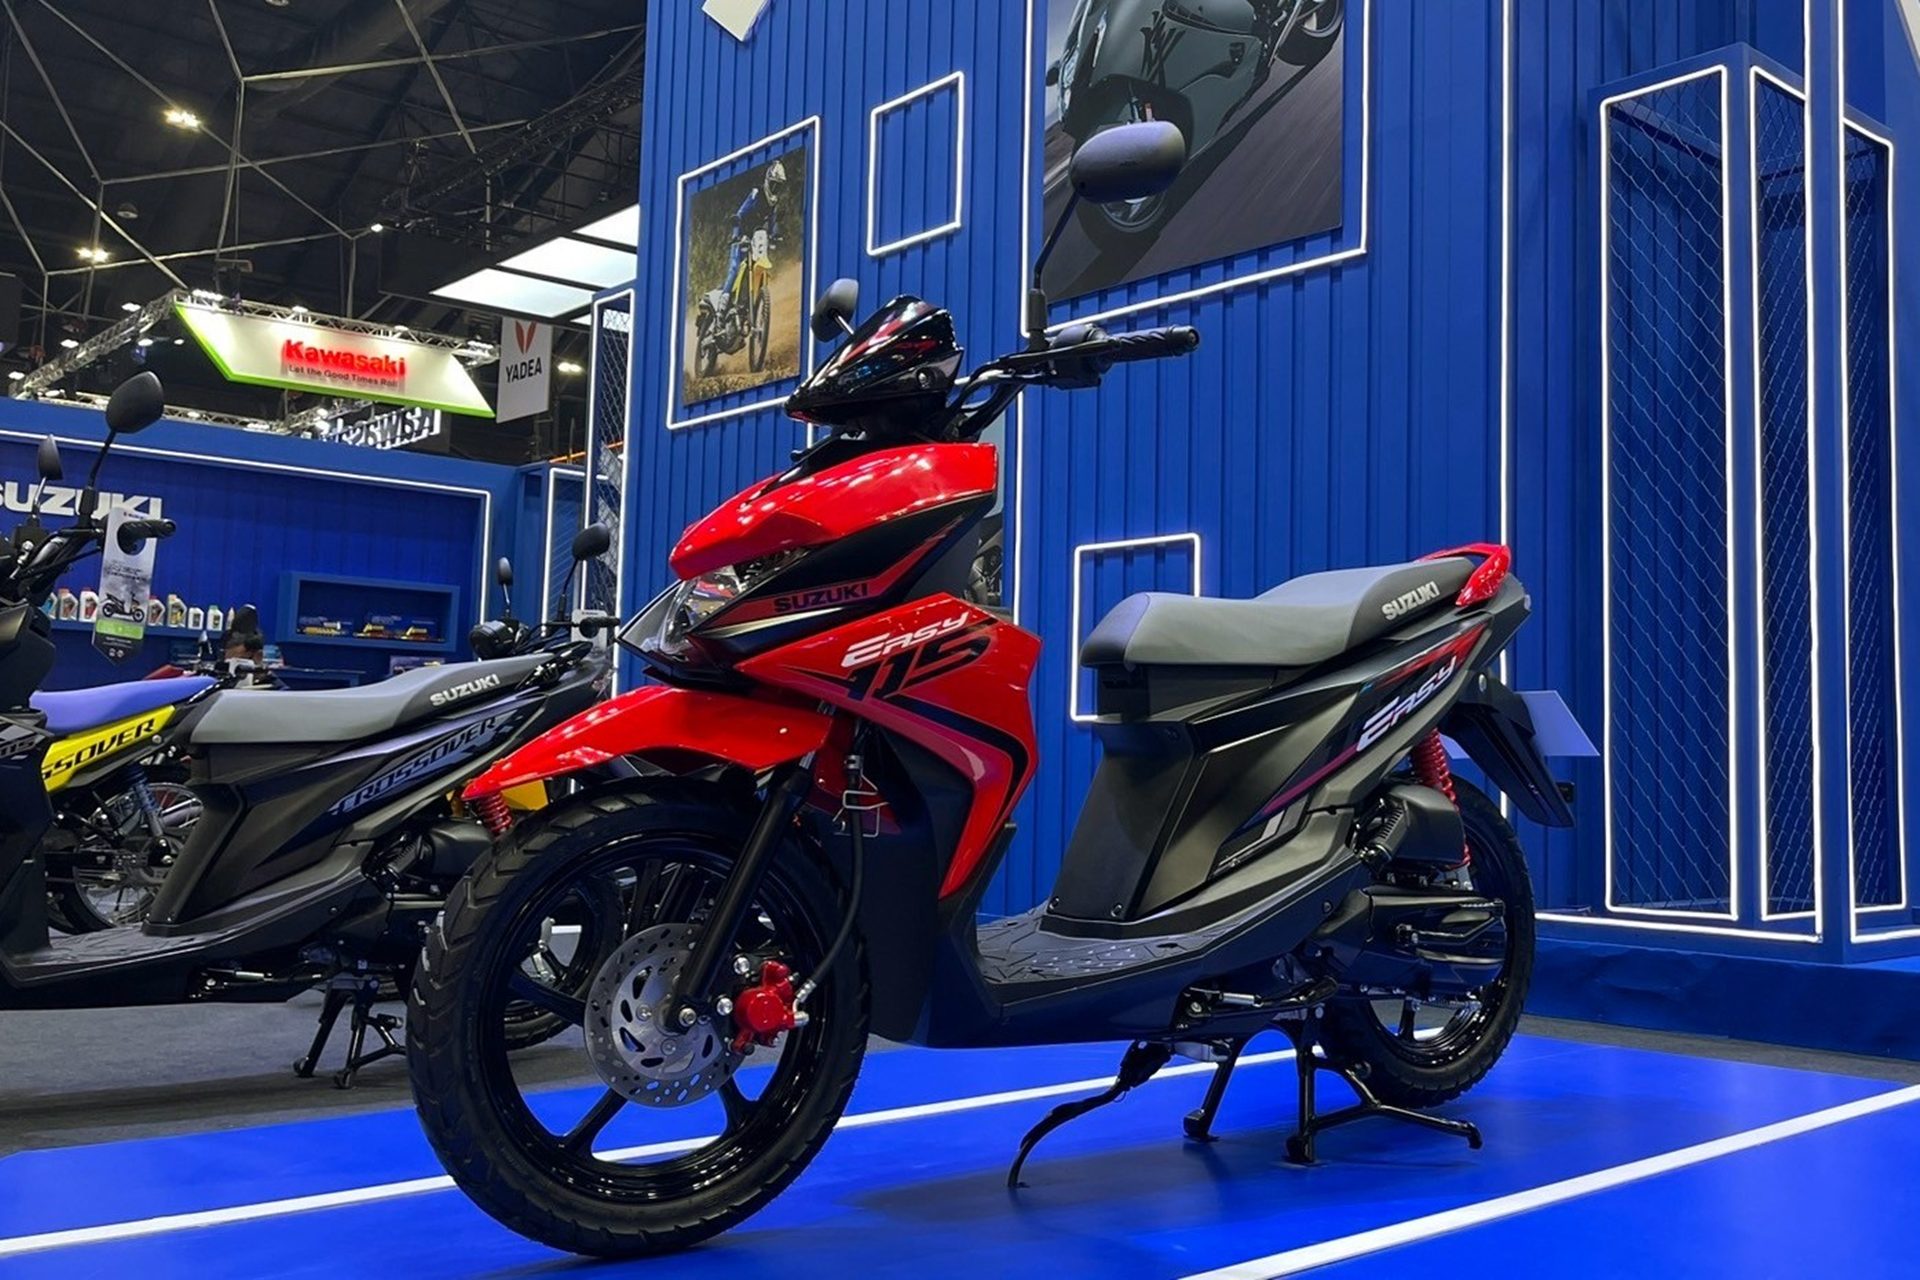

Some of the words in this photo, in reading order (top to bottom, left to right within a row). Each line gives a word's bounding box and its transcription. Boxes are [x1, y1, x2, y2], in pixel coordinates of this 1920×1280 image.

[284, 339, 406, 376] Kawasaki
[307, 367, 322, 376] the
[324, 369, 349, 381] Good
[352, 374, 378, 385] Times
[506, 357, 542, 383] YADEA
[0, 481, 162, 521] UZUKI
[774, 582, 868, 613] SUZUKI
[1381, 580, 1440, 621] SUZUKI
[845, 634, 992, 702] 115
[430, 673, 501, 707] SUZUKI
[337, 716, 497, 812] CROSSOVER
